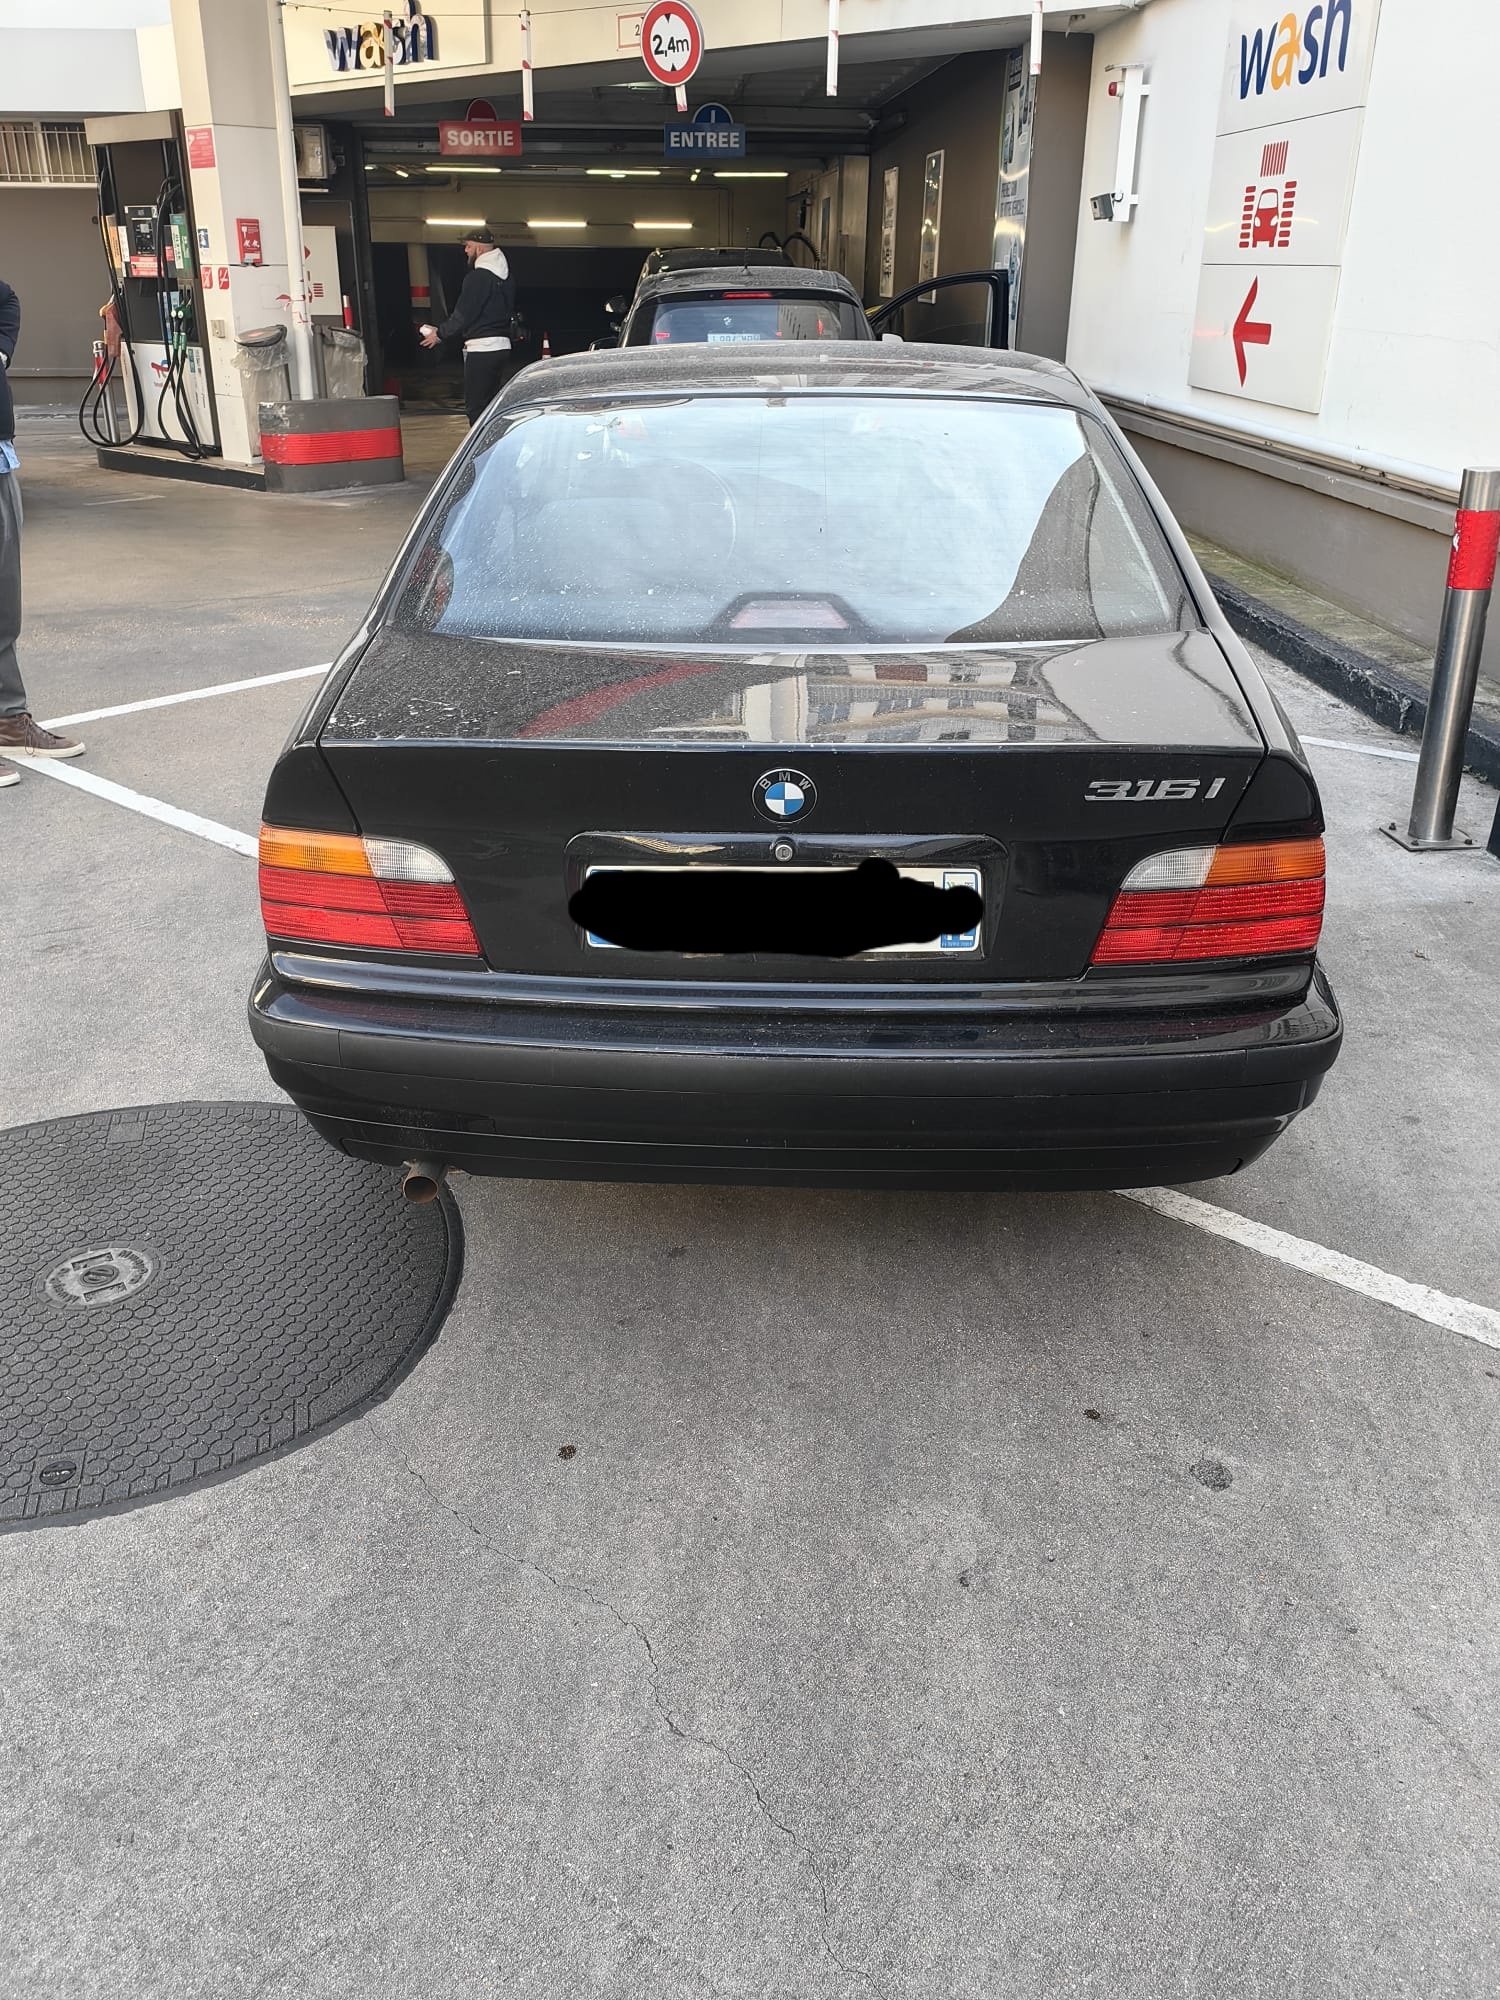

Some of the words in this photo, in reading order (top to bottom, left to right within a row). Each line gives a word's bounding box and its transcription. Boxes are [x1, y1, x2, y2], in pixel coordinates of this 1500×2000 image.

[323, 0, 435, 72] wash
[652, 34, 690, 57] 2,4m
[1239, 0, 1352, 100] wash
[447, 129, 514, 147] SORTIE
[669, 131, 741, 149] ENTREE
[759, 771, 812, 790] BMW
